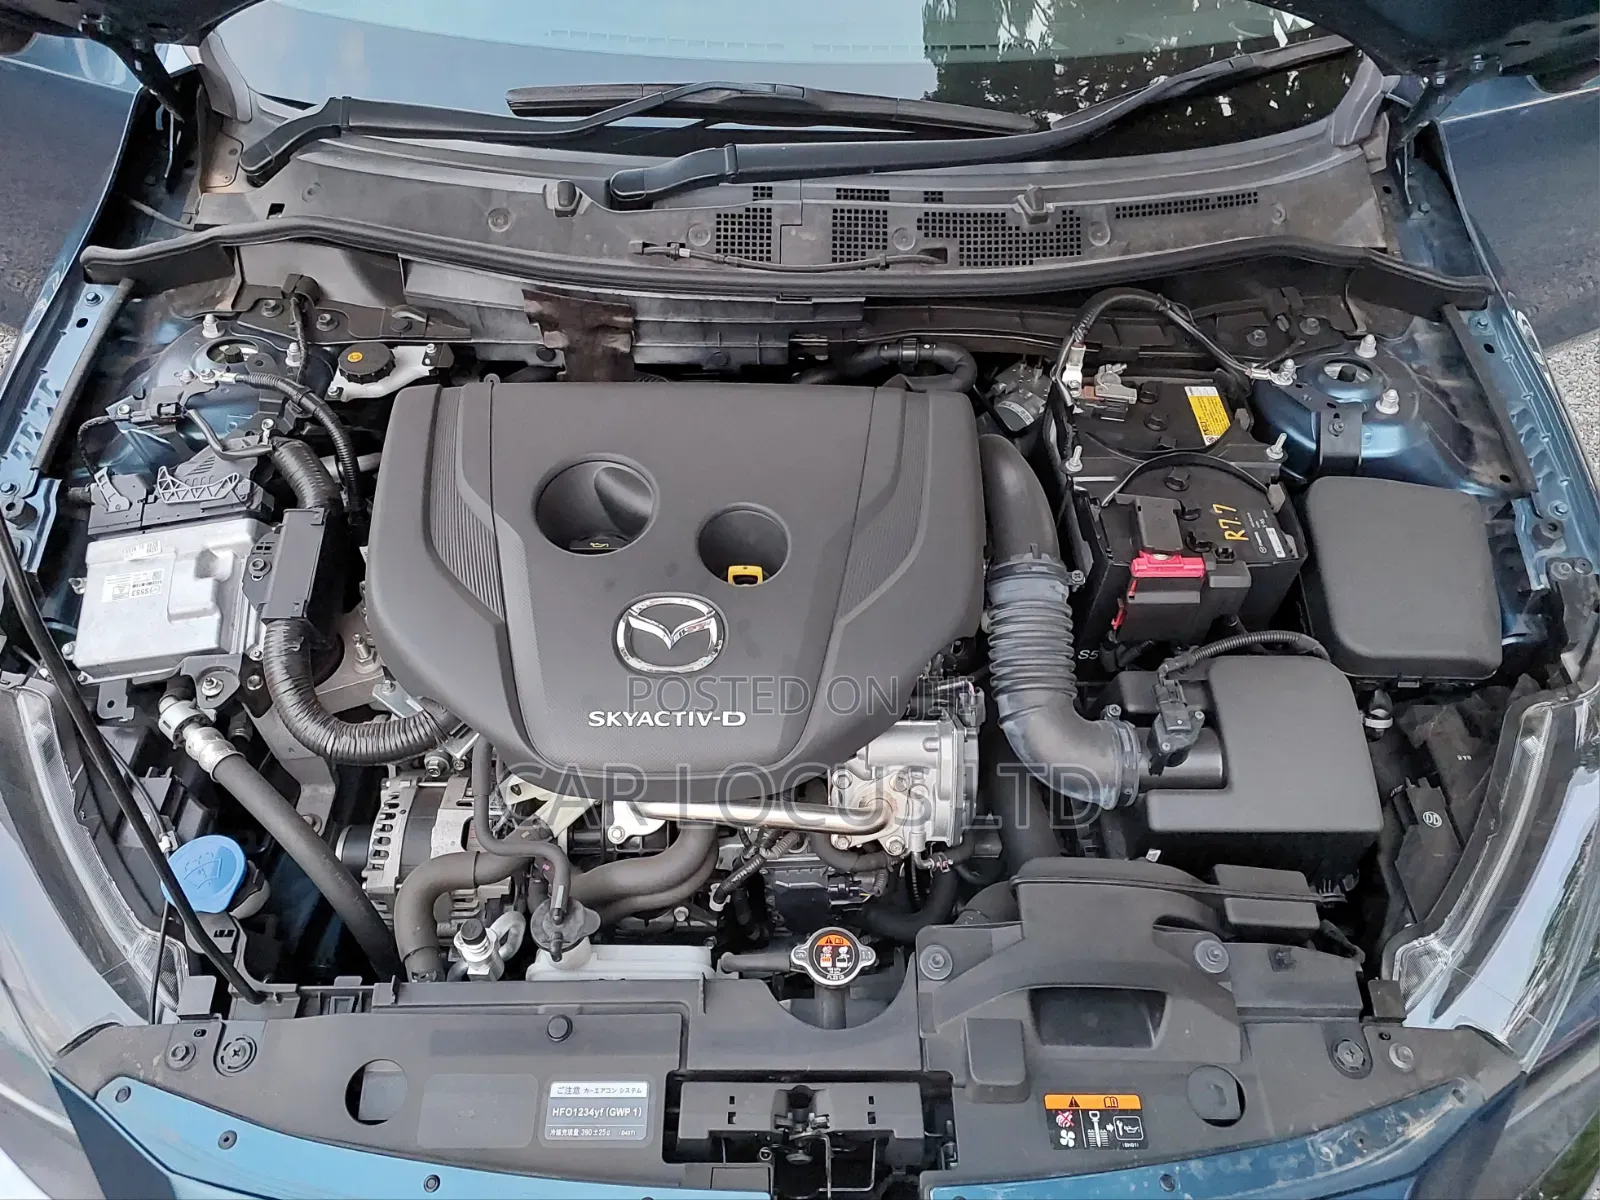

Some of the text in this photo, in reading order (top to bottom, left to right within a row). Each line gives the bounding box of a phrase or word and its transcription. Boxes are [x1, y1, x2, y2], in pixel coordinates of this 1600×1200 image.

[588, 710, 747, 727] SKYACTIV-D
[557, 1086, 581, 1095] ご注意
[552, 1106, 642, 1119] HFO1234yf (GWP 1)
